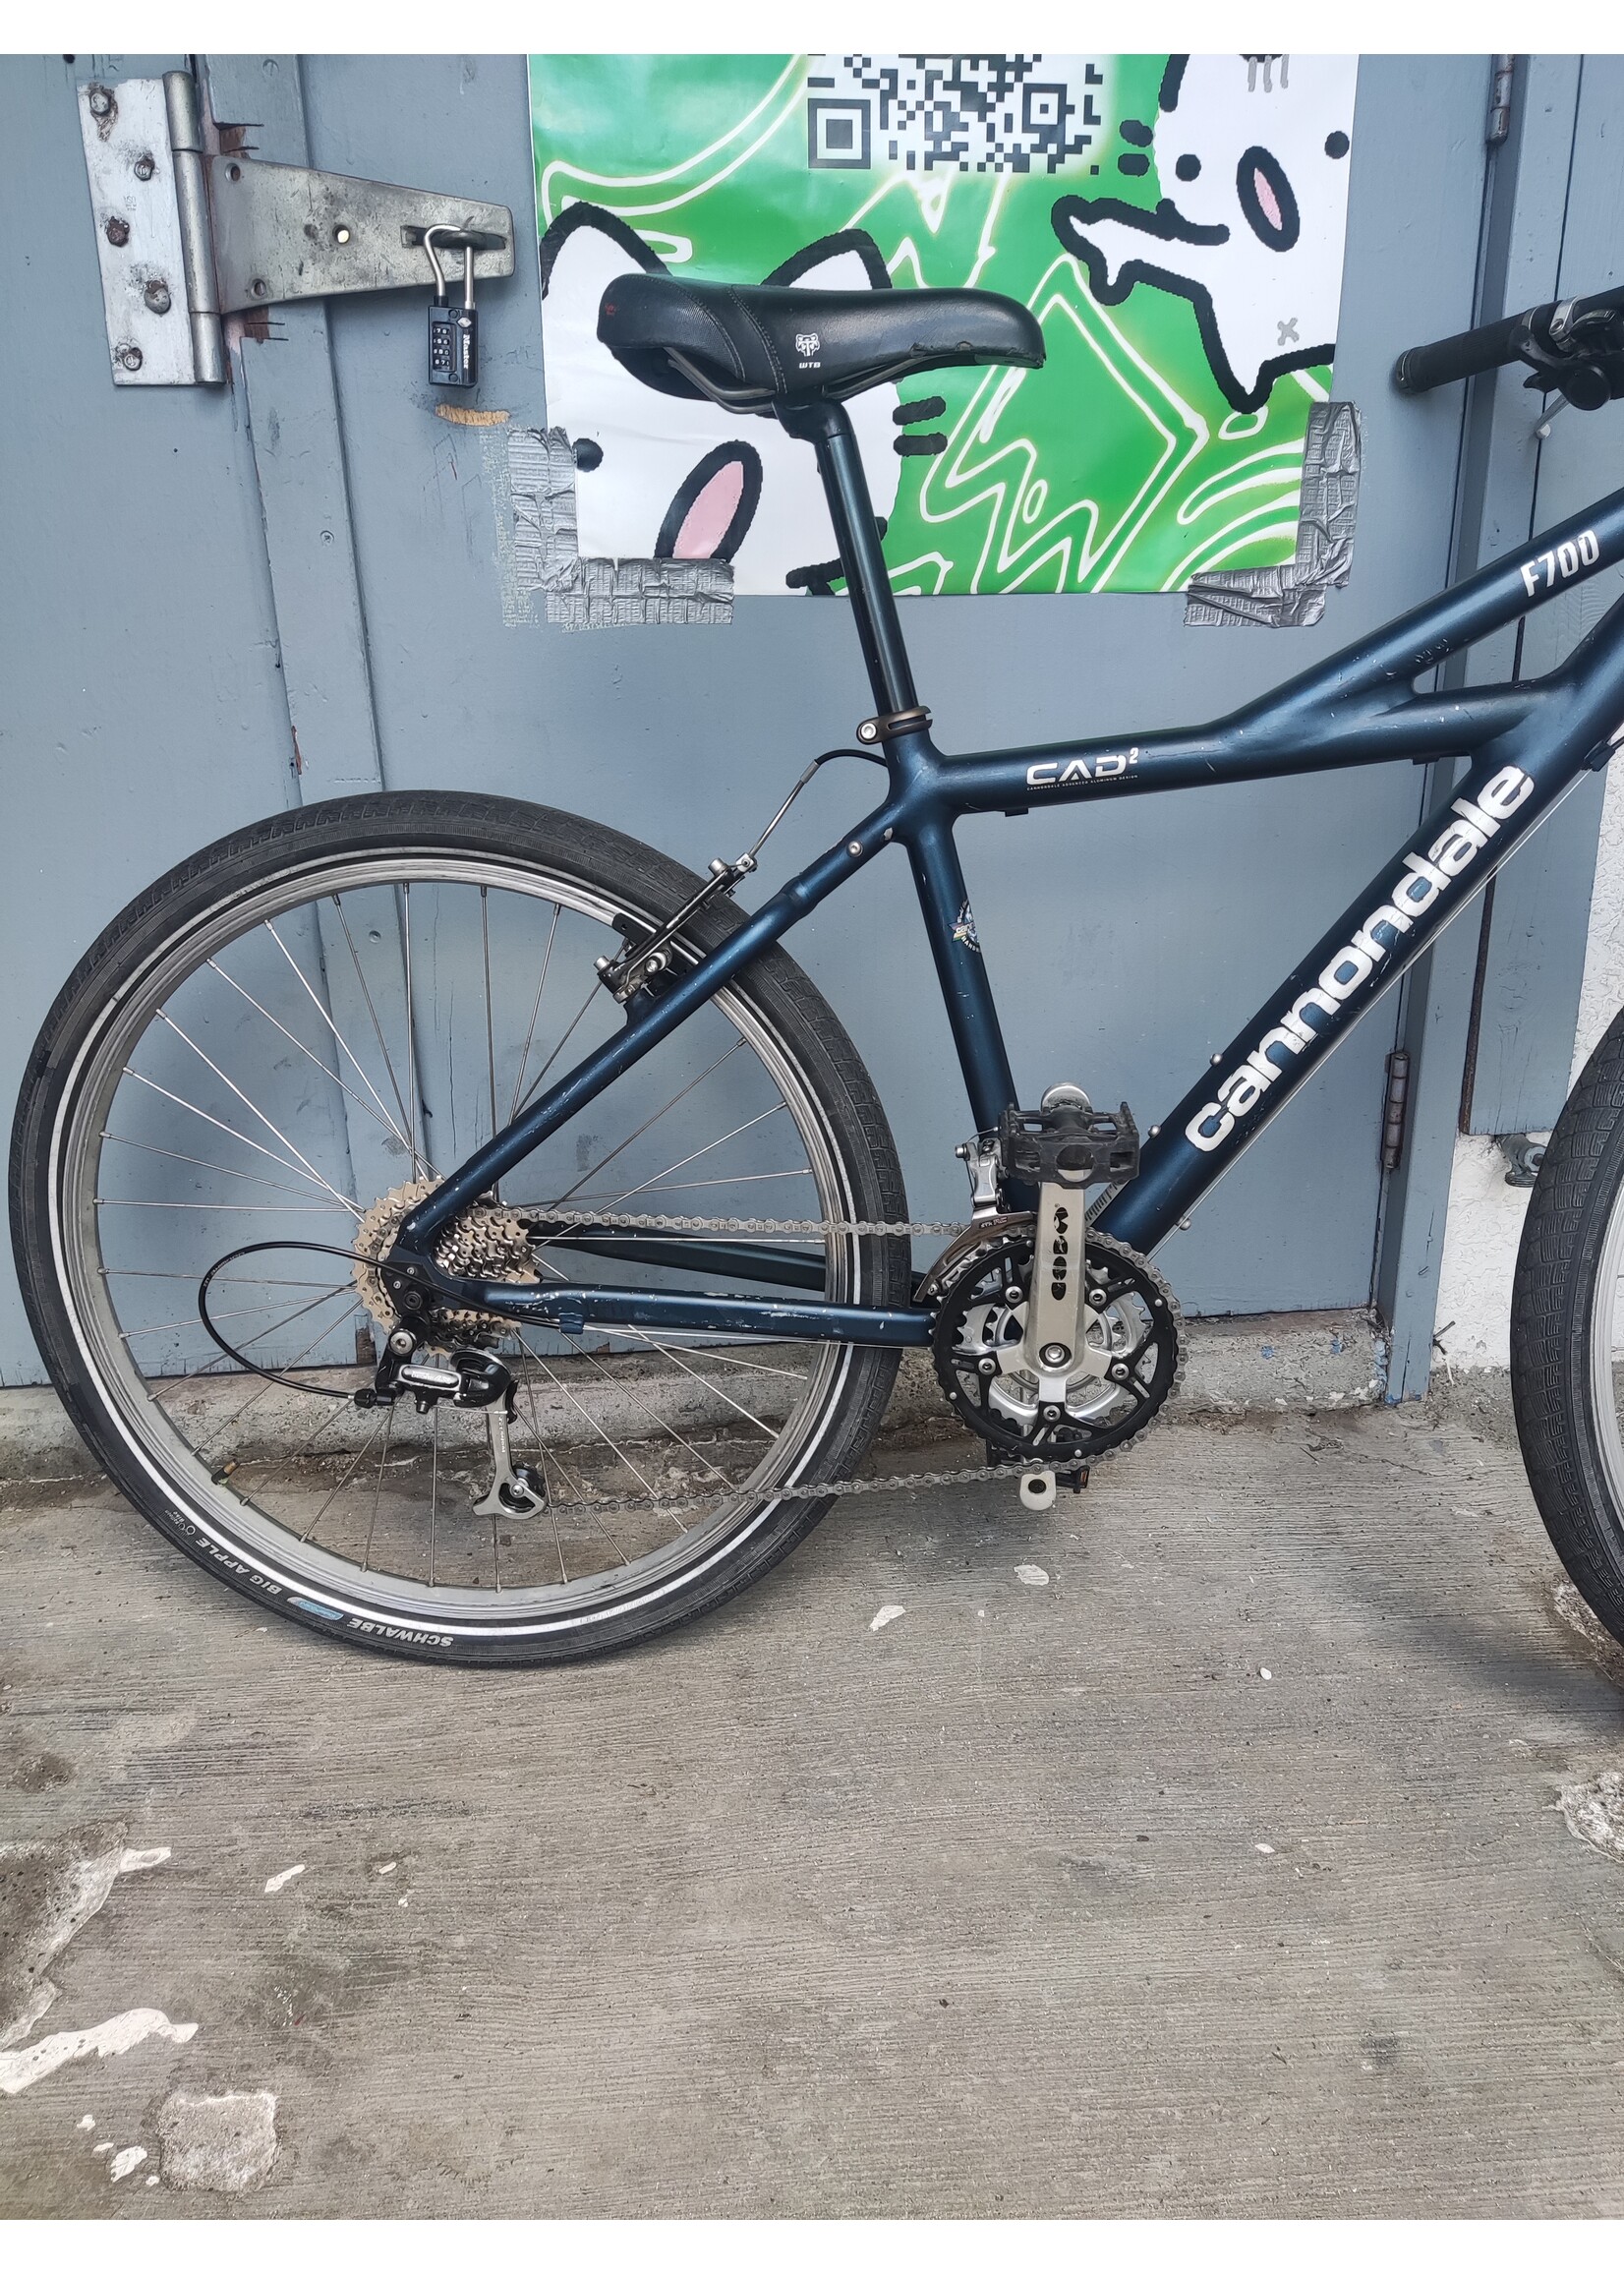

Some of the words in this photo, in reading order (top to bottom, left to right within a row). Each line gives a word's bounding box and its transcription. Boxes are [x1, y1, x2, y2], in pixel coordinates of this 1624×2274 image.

[462, 333, 471, 369] Master
[1520, 529, 1600, 598] F700
[1185, 765, 1536, 1152] cannondale
[194, 1537, 250, 1576] APPLE
[249, 1574, 283, 1595] BIG
[346, 1616, 454, 1648] SCHWALBE
